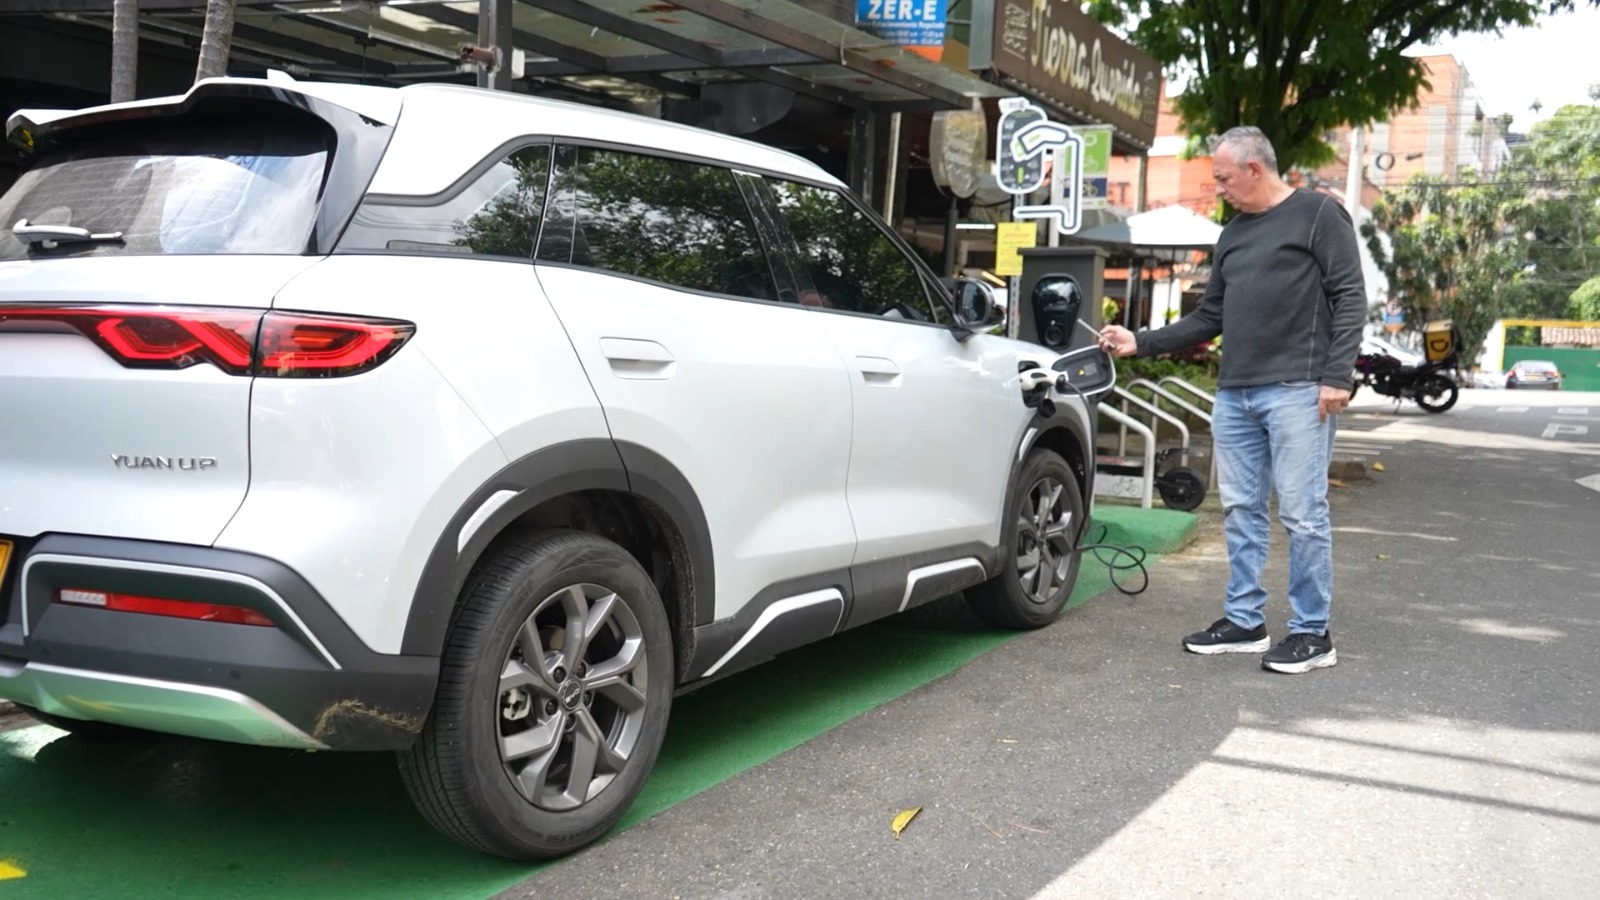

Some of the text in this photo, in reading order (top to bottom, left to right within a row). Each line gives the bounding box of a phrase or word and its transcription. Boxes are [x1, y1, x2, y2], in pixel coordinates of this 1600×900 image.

[867, 0, 938, 20] ZER-E
[110, 453, 217, 470] YUAN UP
